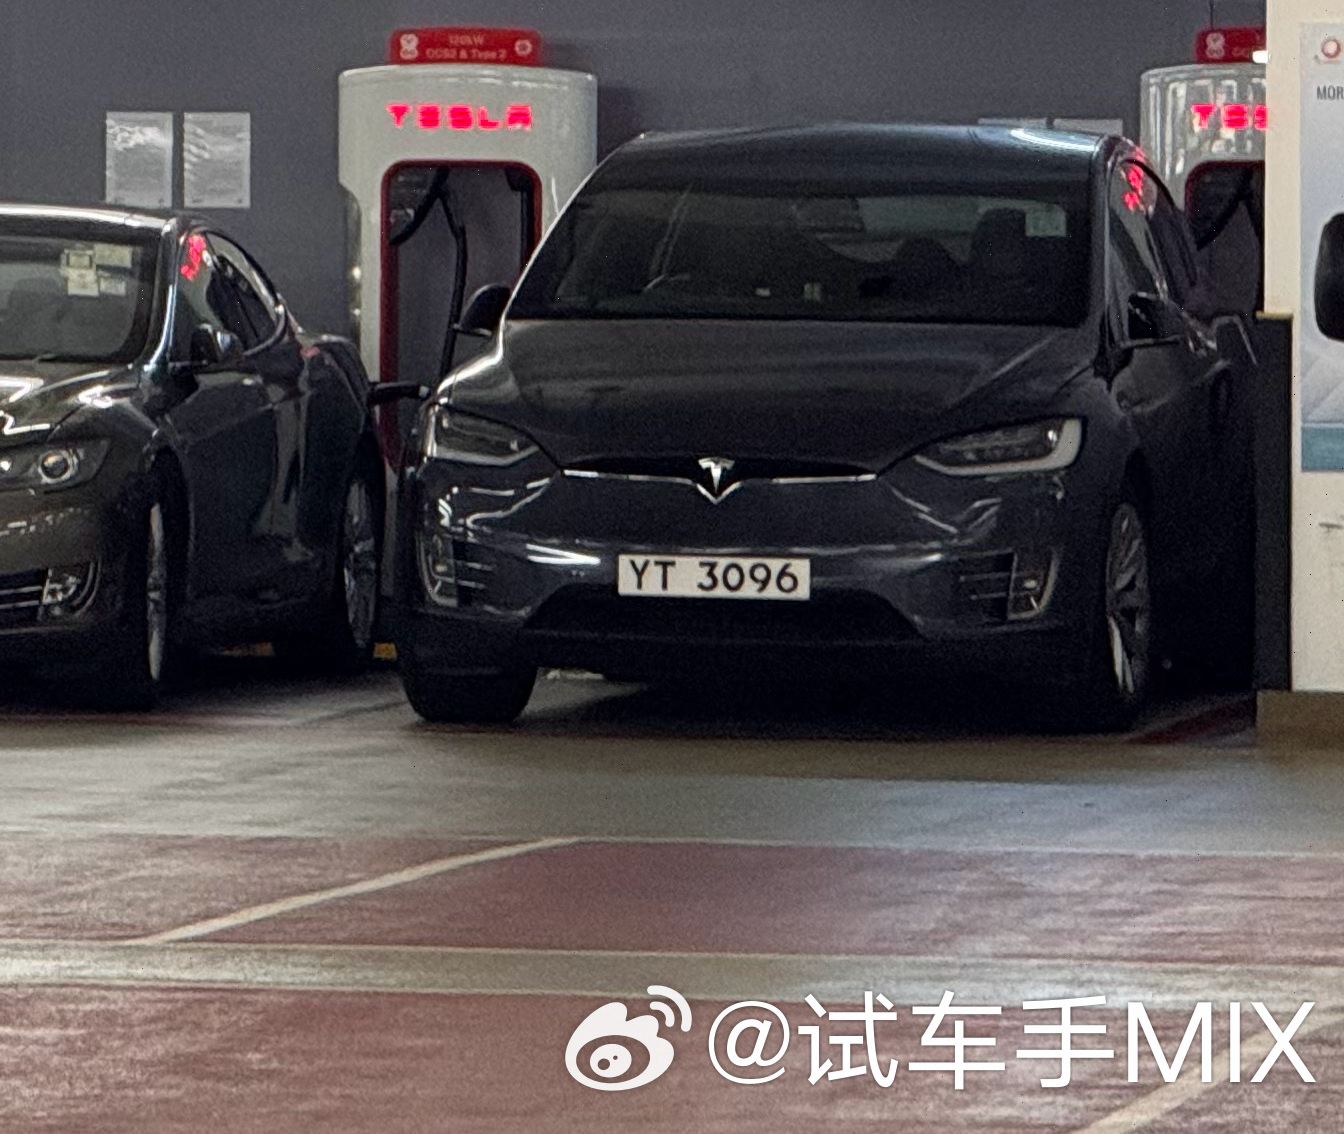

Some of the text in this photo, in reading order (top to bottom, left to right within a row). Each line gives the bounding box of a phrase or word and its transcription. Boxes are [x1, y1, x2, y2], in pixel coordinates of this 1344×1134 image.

[472, 49, 496, 60] Type
[497, 49, 507, 59] 2
[387, 104, 533, 130] TESLA
[629, 559, 799, 594] YT 3096
